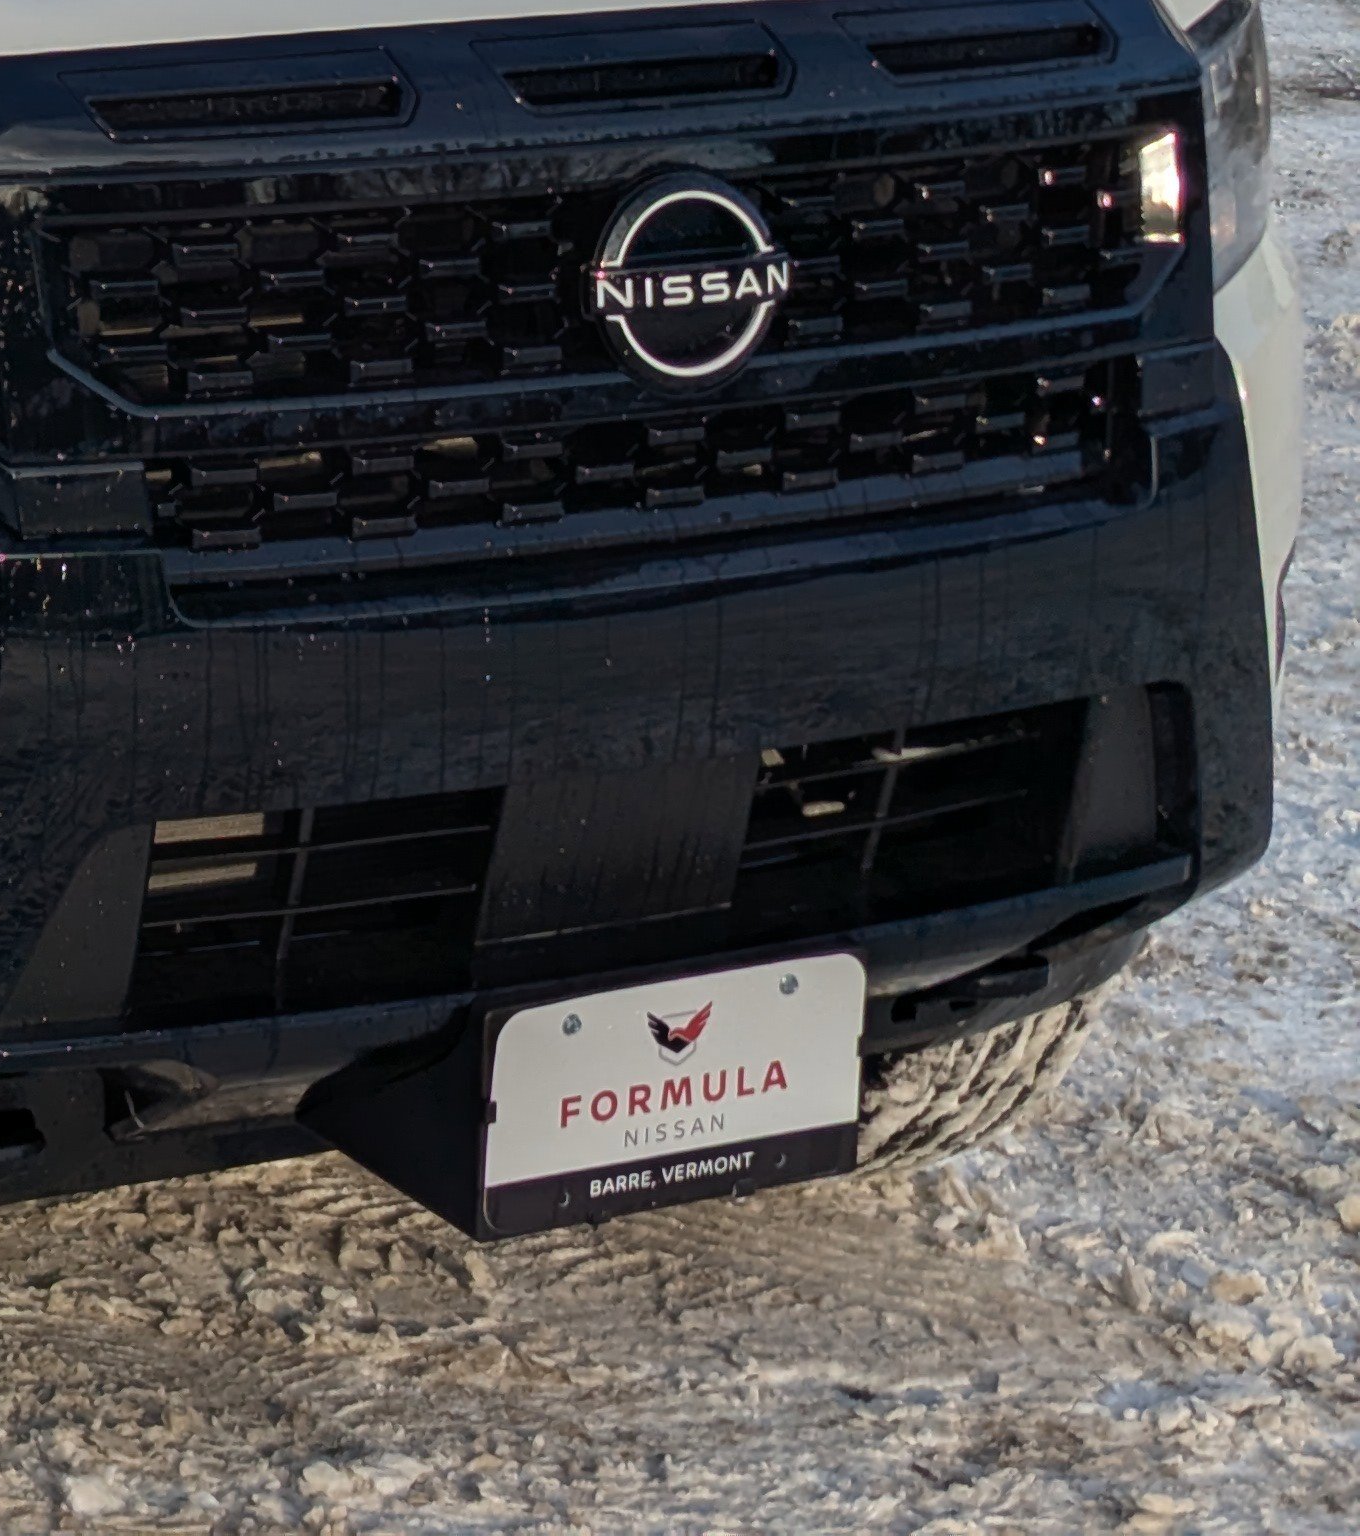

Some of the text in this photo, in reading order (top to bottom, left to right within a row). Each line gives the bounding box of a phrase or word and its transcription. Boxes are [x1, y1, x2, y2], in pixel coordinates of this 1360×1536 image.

[596, 261, 789, 309] NISSAN
[560, 1060, 788, 1128] FORMULA
[624, 1113, 725, 1148] NISSAN
[589, 1151, 755, 1198] BARRE, VERMONT
